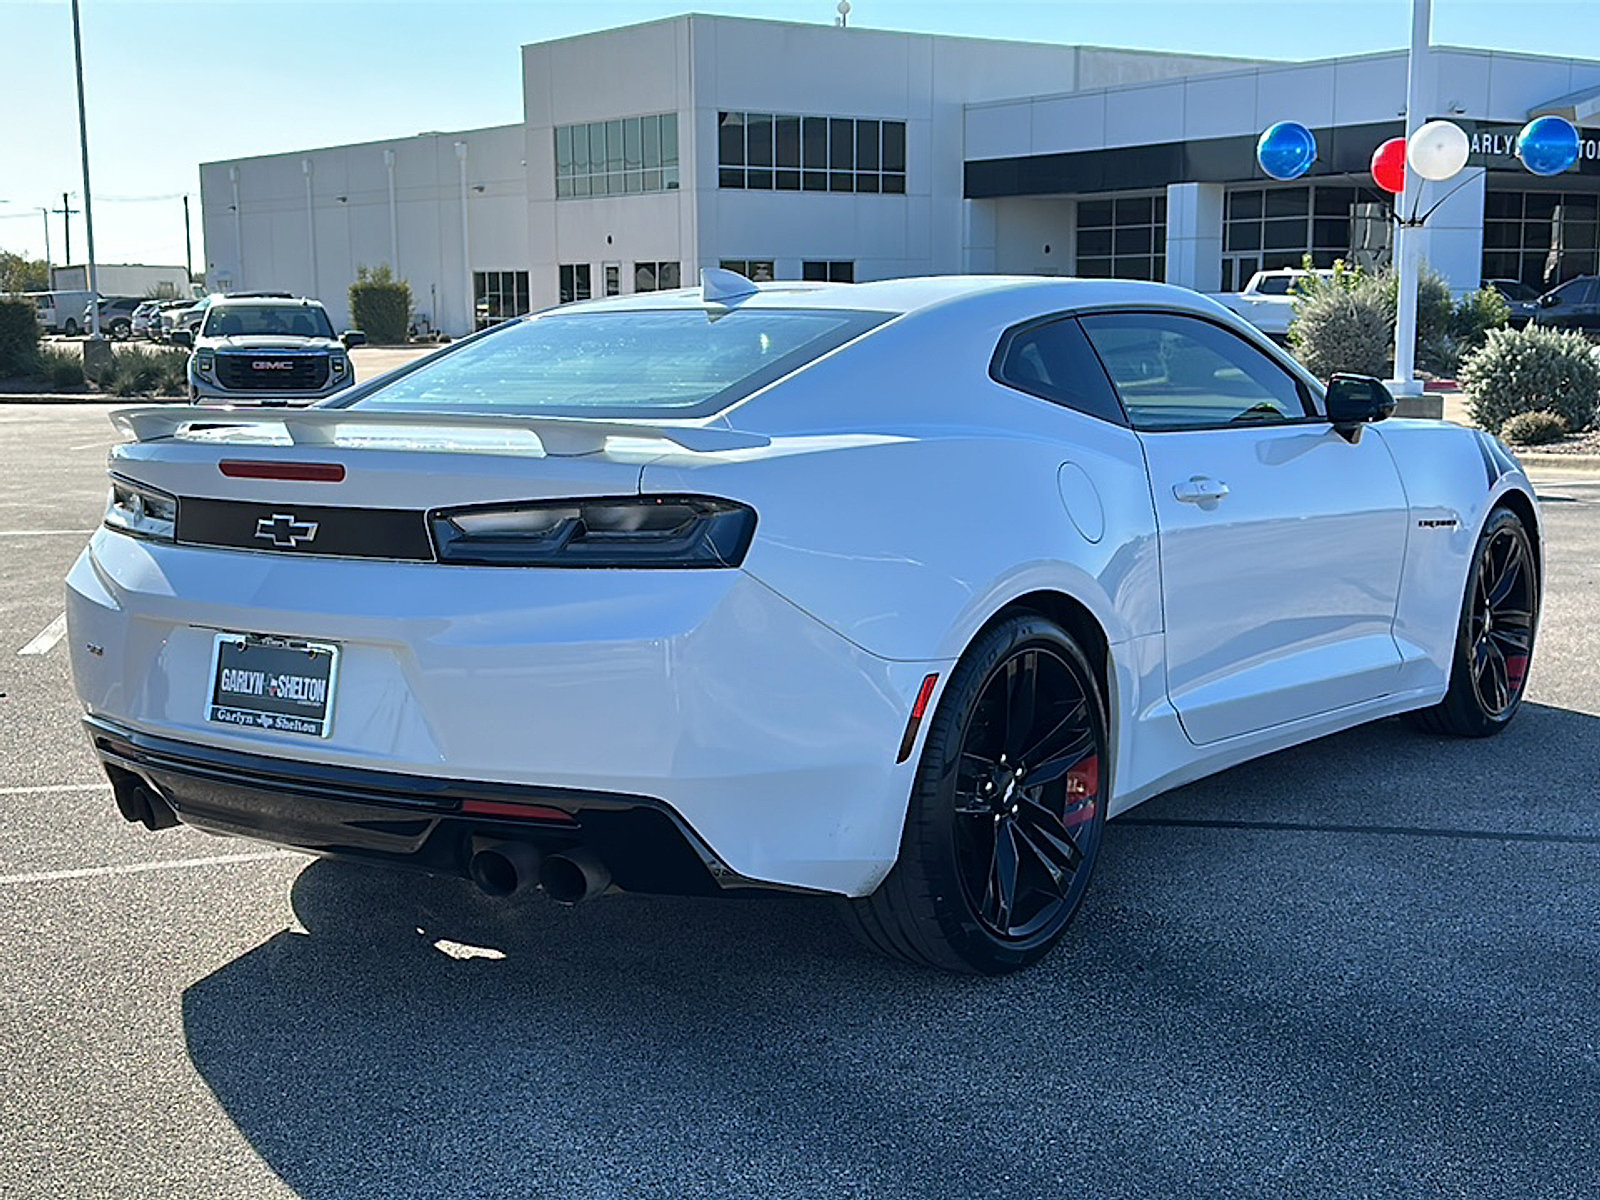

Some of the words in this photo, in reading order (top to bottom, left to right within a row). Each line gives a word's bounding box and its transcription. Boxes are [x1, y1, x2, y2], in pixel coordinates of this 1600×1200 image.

[1470, 133, 1519, 155] ARLY
[252, 361, 294, 370] GMC
[221, 668, 265, 695] GARLYN
[278, 674, 327, 702] SHELTON
[217, 709, 253, 725] Garlyn
[275, 717, 316, 734] Shelton
